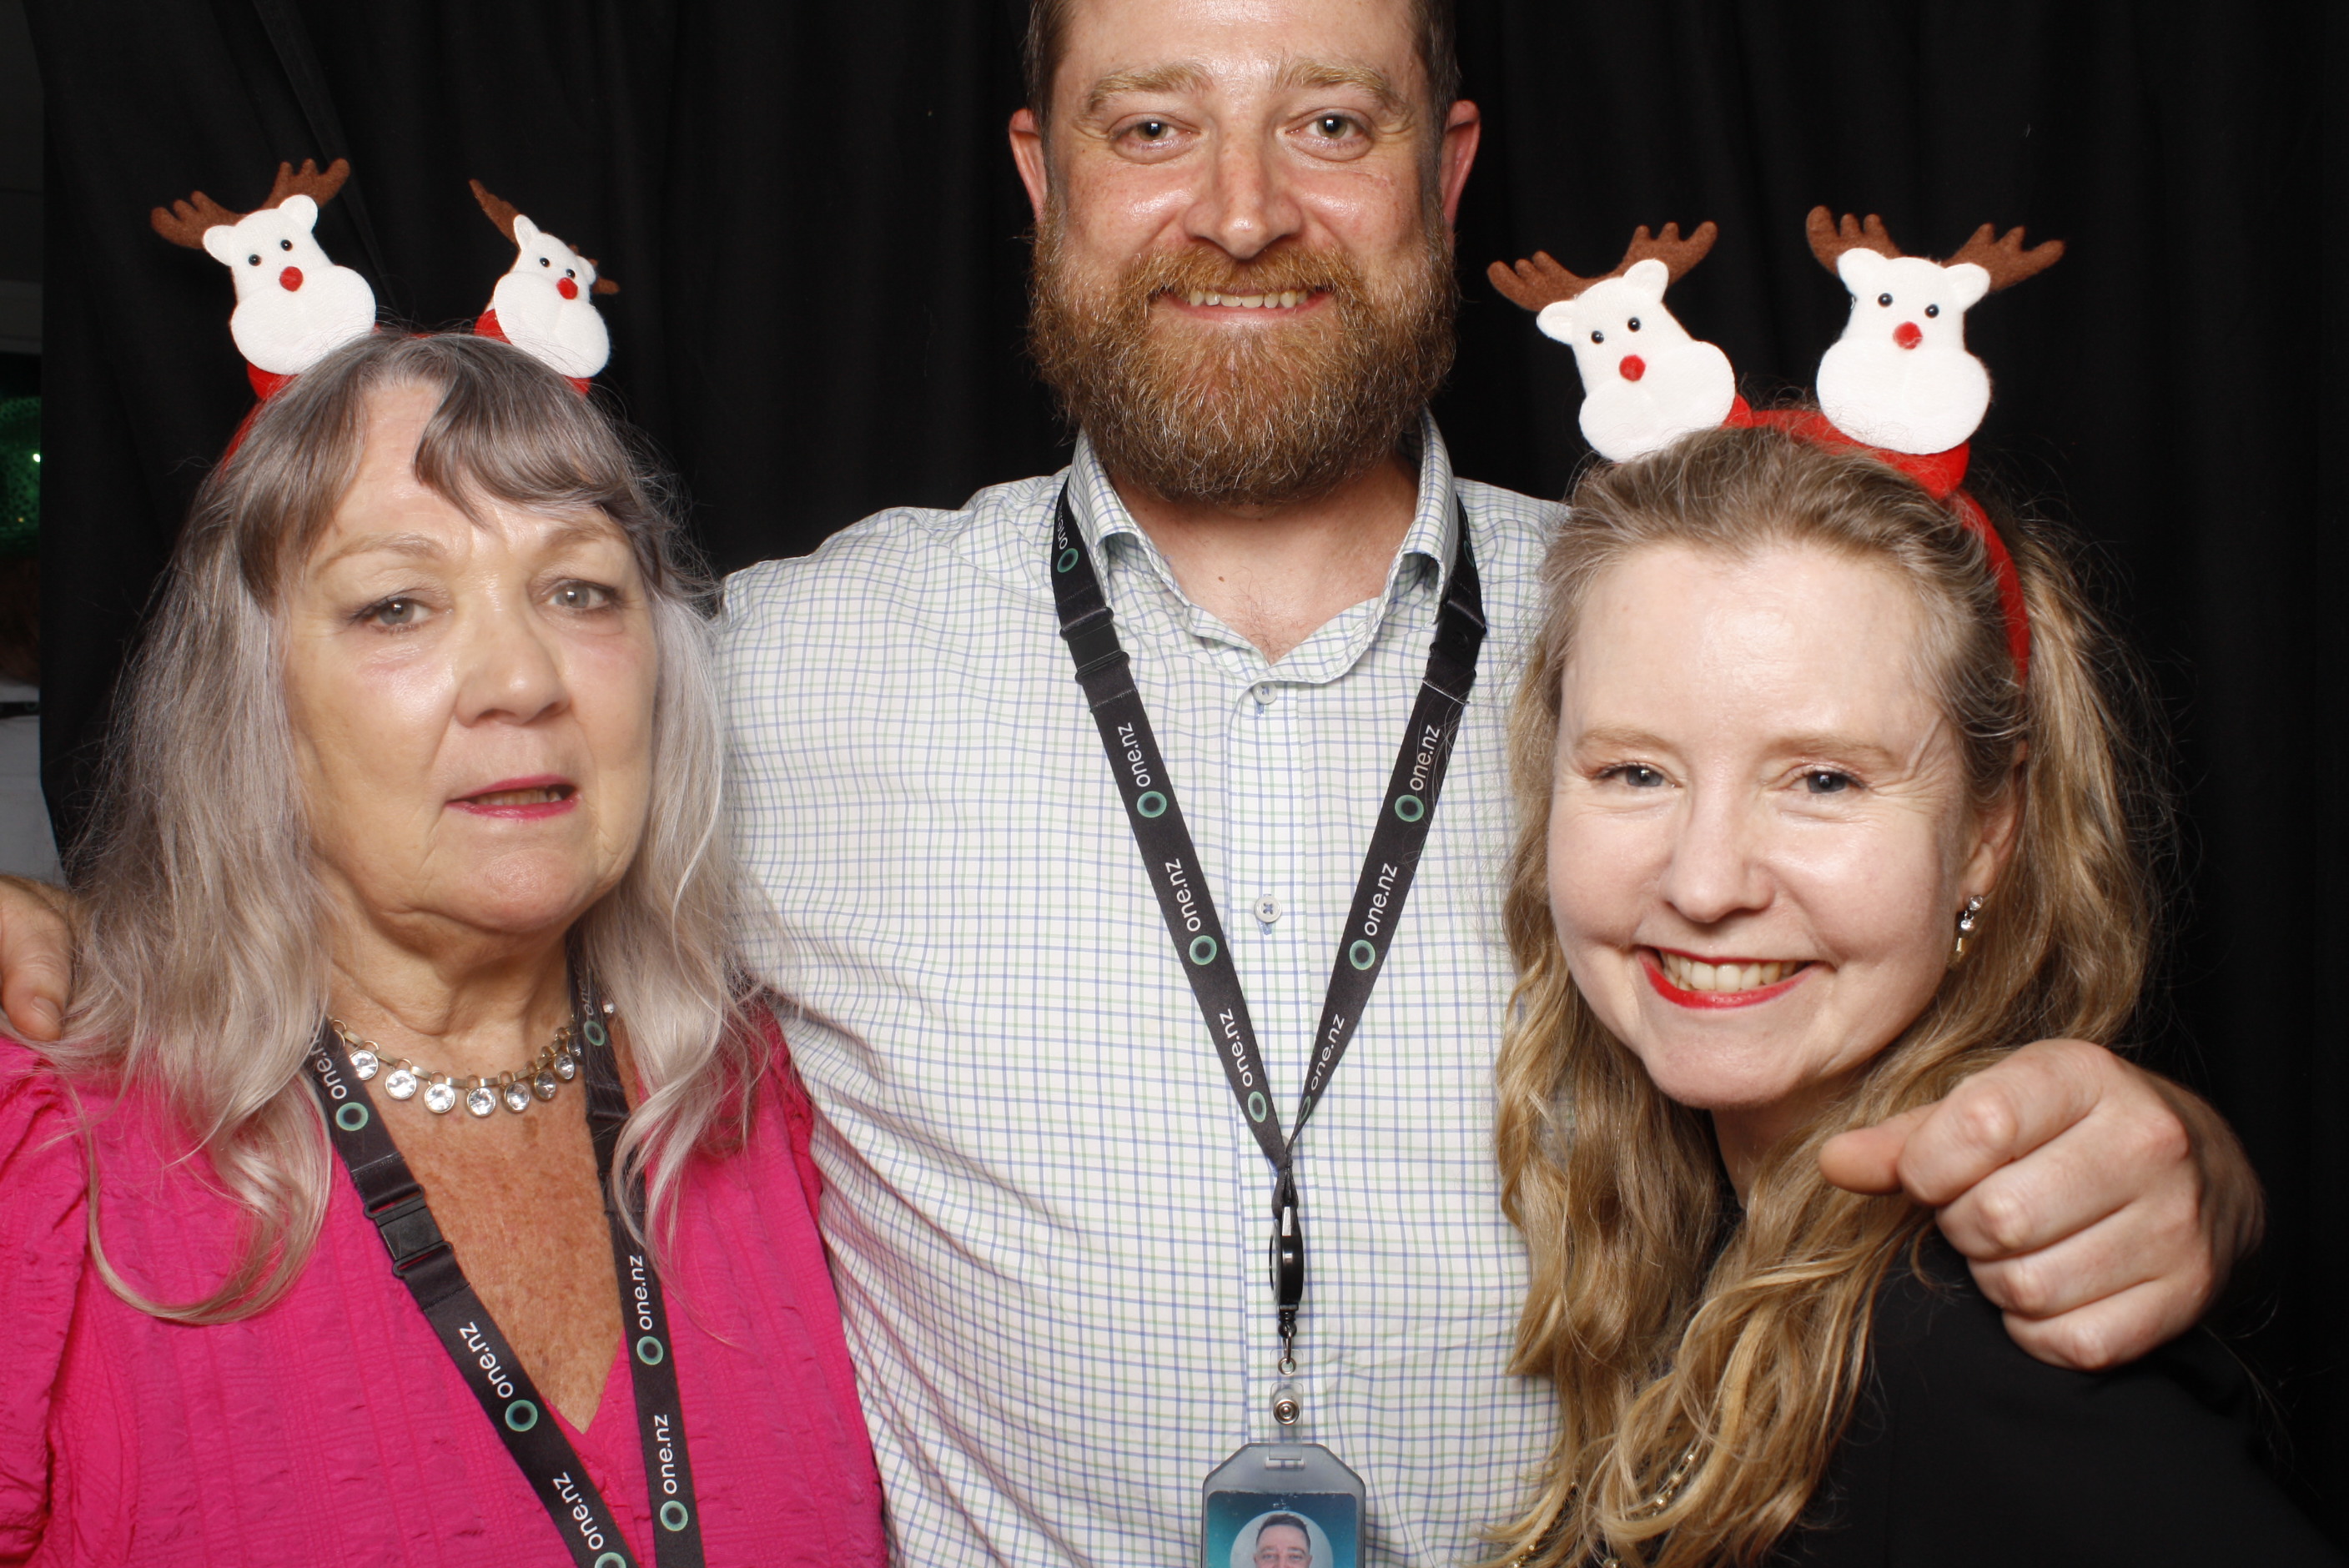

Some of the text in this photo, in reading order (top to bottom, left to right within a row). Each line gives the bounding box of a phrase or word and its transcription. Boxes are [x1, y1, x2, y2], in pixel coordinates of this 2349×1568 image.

[1057, 502, 1069, 550] one.
[1117, 721, 1151, 787] one.nz
[1409, 724, 1441, 792] one.nz
[1164, 857, 1201, 932] one.nz
[1364, 862, 1398, 937] one.nz
[309, 1039, 348, 1100] one.n
[1219, 1008, 1254, 1088] one.nz
[1310, 1013, 1346, 1091] one.nz
[629, 1254, 653, 1330] one.nz
[459, 1321, 514, 1399] one.nz
[654, 1414, 677, 1495] one.nz
[552, 1471, 604, 1550] one.nz
